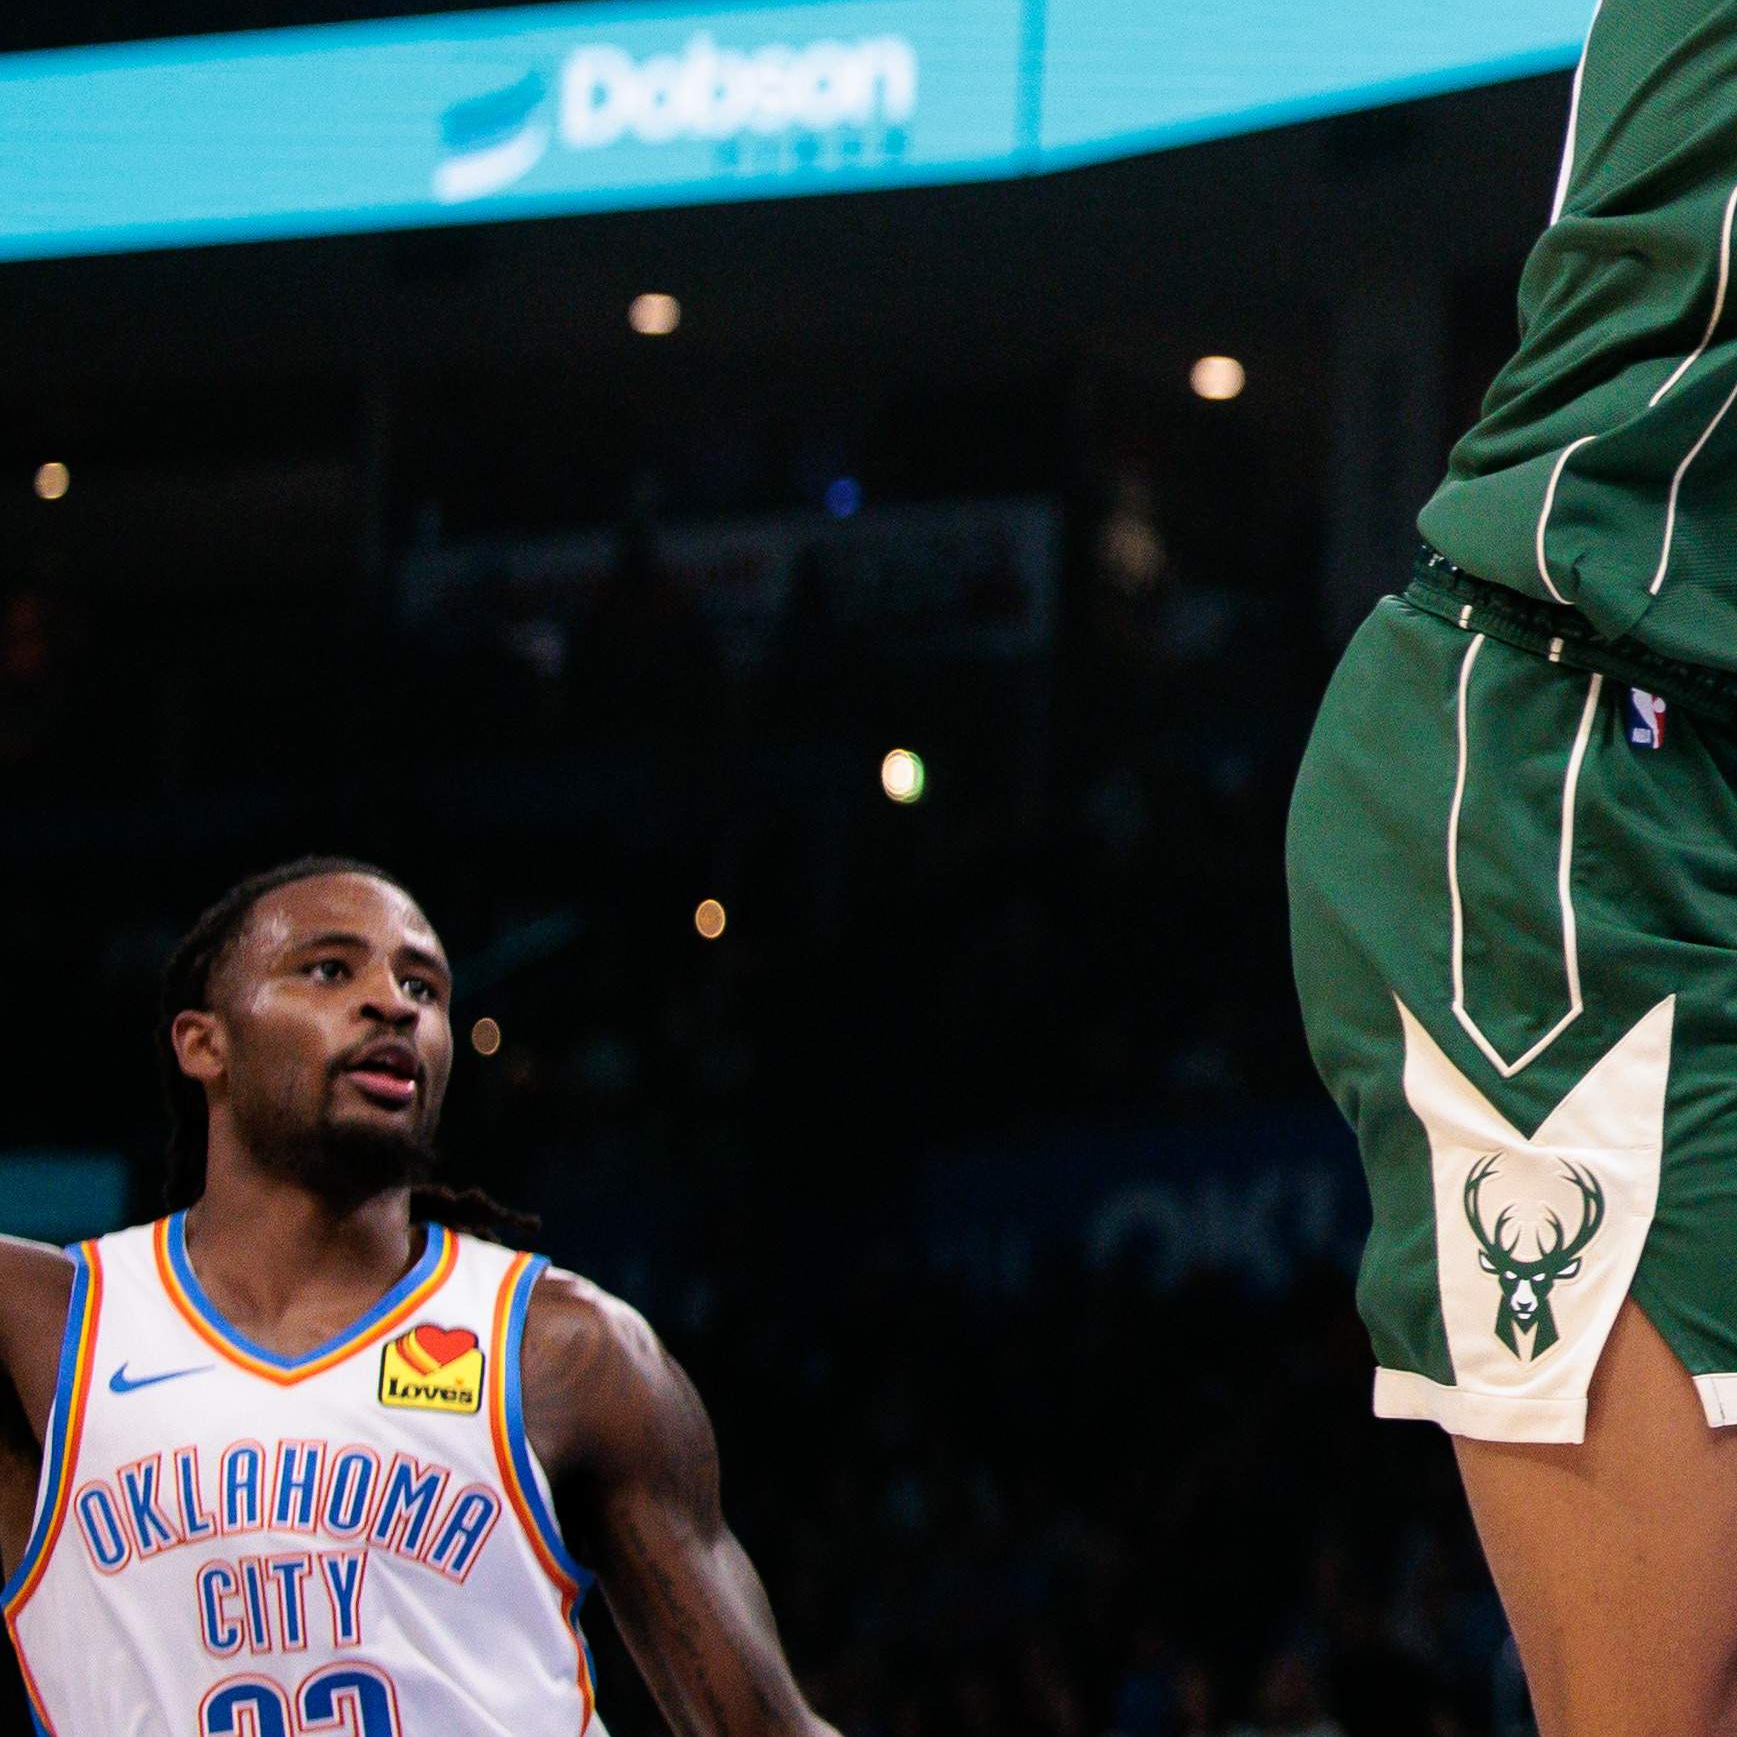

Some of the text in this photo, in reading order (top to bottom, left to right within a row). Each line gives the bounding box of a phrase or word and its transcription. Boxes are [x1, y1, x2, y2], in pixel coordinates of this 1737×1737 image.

[559, 30, 917, 149] Dobson
[74, 1438, 501, 1586] OKLAHOMA
[197, 1548, 368, 1659] CITY
